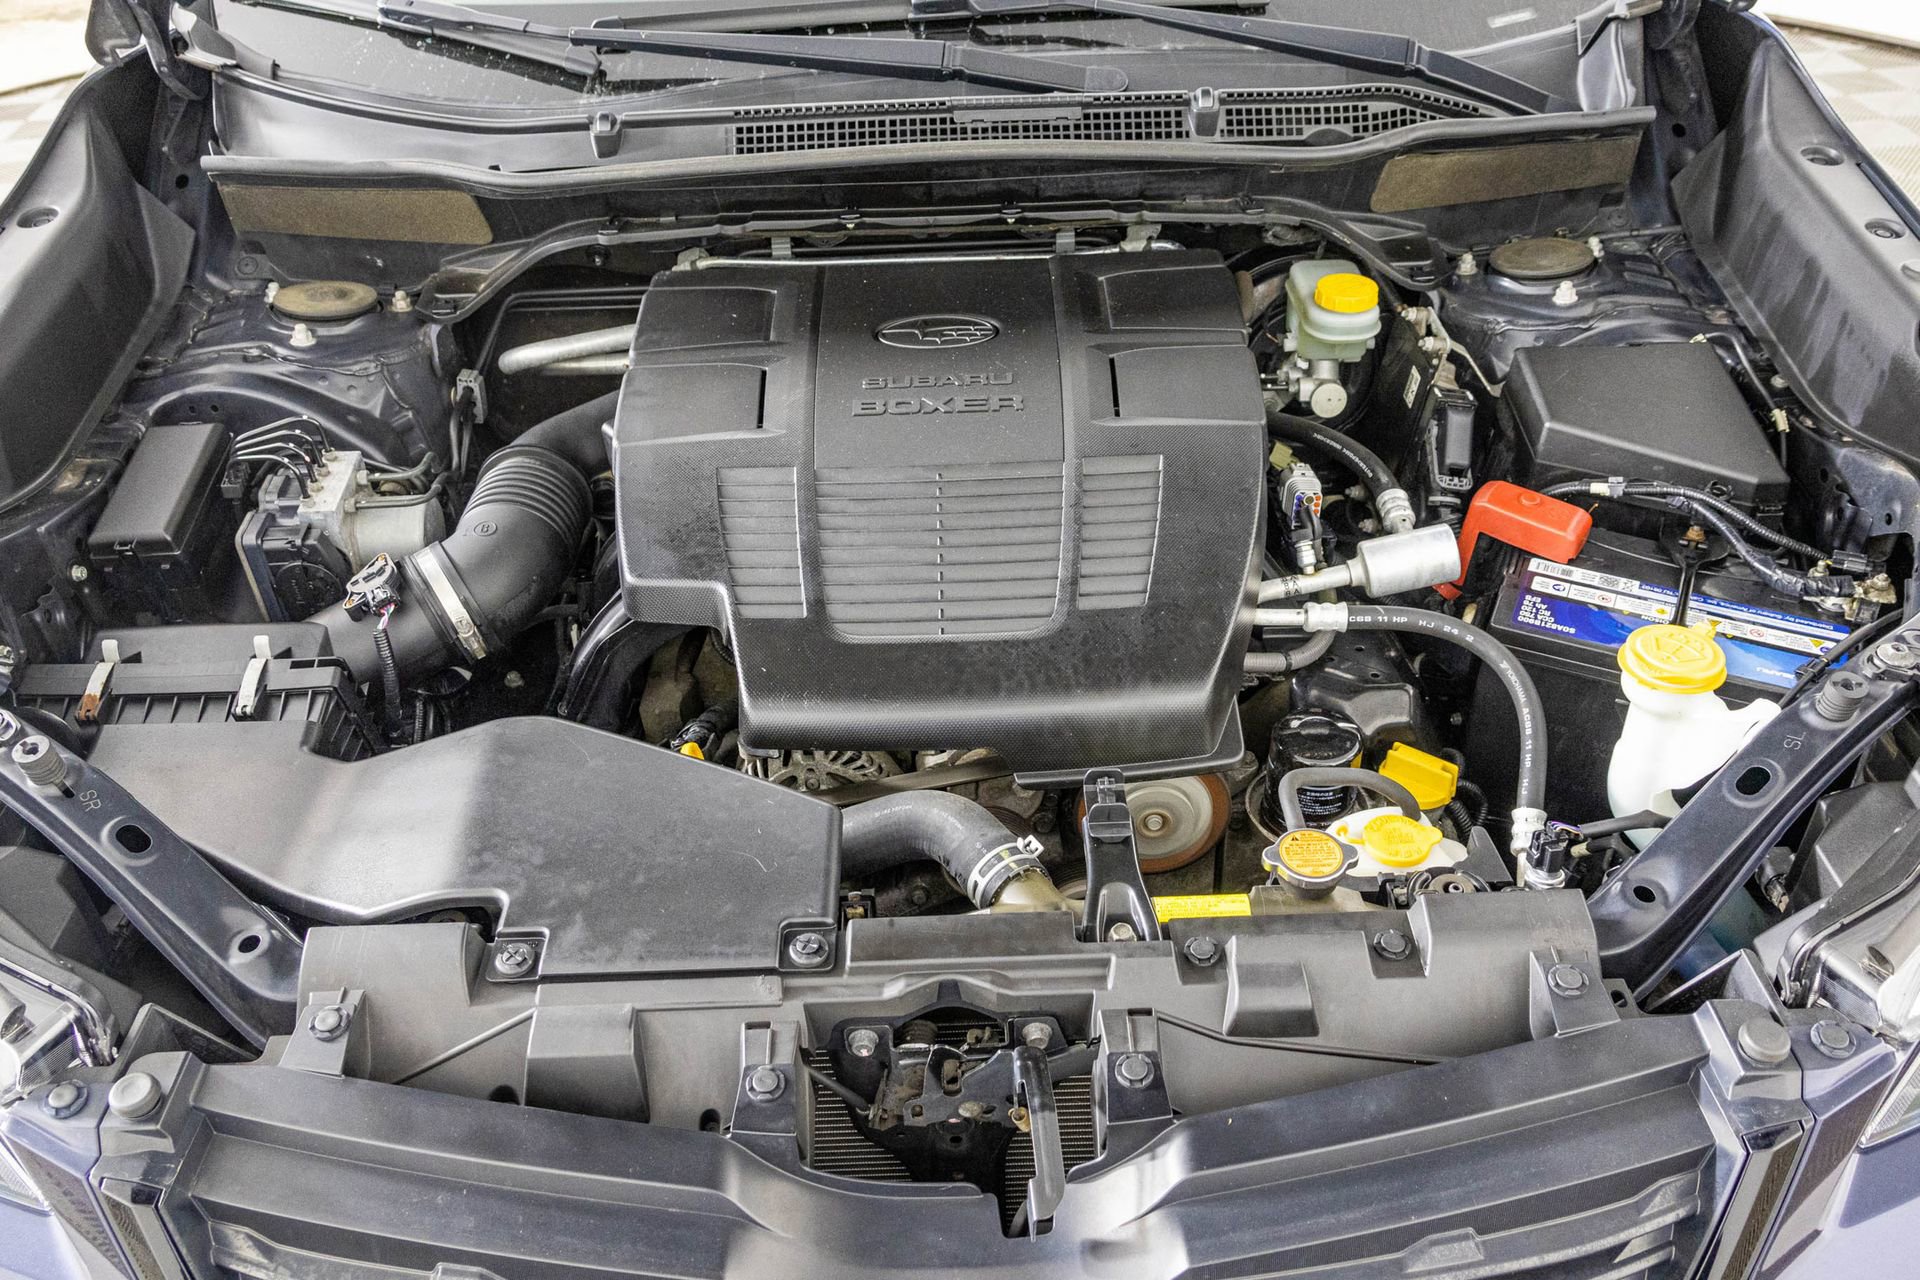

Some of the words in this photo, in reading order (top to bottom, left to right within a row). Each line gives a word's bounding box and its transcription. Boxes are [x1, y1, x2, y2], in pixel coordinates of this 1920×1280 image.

[862, 372, 1013, 389] SUBARU
[852, 395, 1024, 416] BOXER
[1418, 619, 1435, 628] HJ
[1537, 613, 1554, 622] CCA
[1525, 739, 1533, 750] 11
[1784, 731, 1807, 750] SL
[1524, 753, 1532, 768] HP
[1521, 778, 1529, 795] HJ
[80, 790, 101, 812] SR
